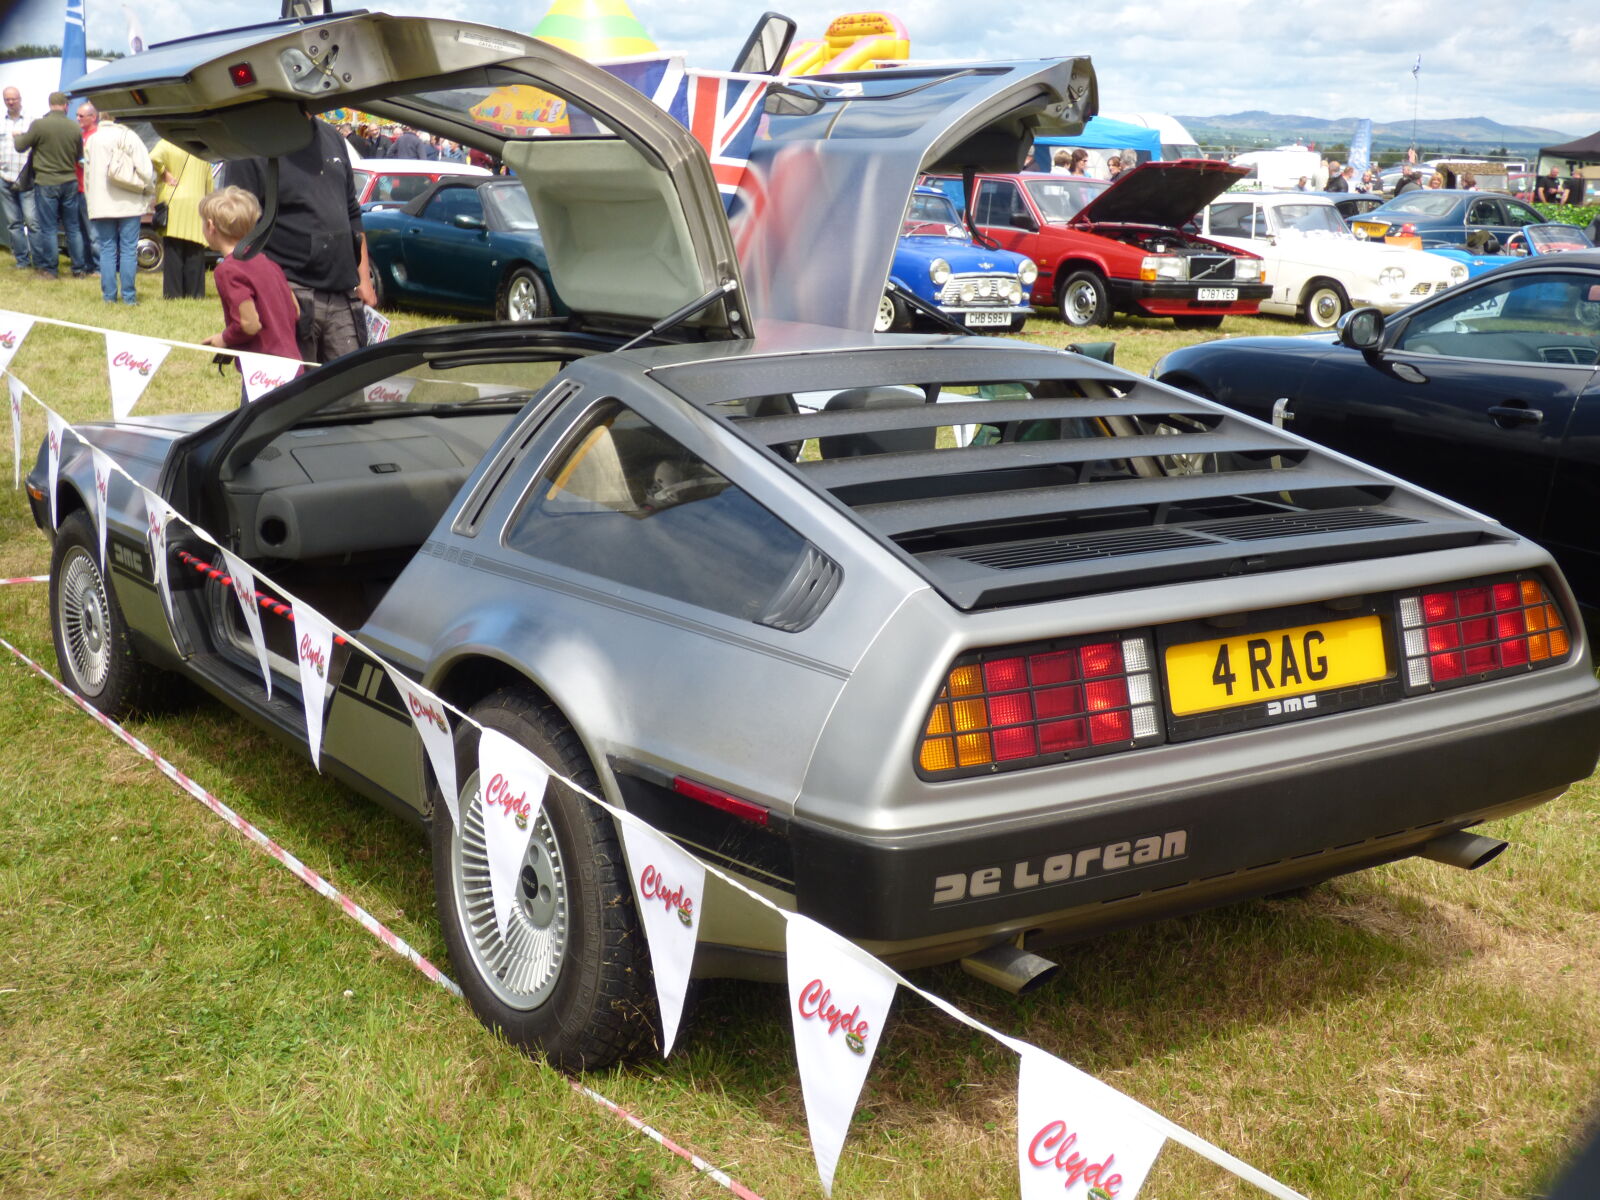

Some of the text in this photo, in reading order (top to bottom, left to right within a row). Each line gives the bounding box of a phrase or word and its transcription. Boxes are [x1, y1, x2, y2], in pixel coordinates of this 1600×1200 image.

[1221, 289, 1235, 299] YES
[969, 312, 1009, 324] CHB 585V
[113, 351, 152, 371] Clyde
[300, 633, 325, 668] Clyde
[1212, 630, 1328, 696] 4 RAG
[485, 773, 531, 819] Clyde
[640, 864, 693, 913] Clyde
[798, 978, 869, 1040] Clyde
[1027, 1120, 1123, 1197] Clyde
